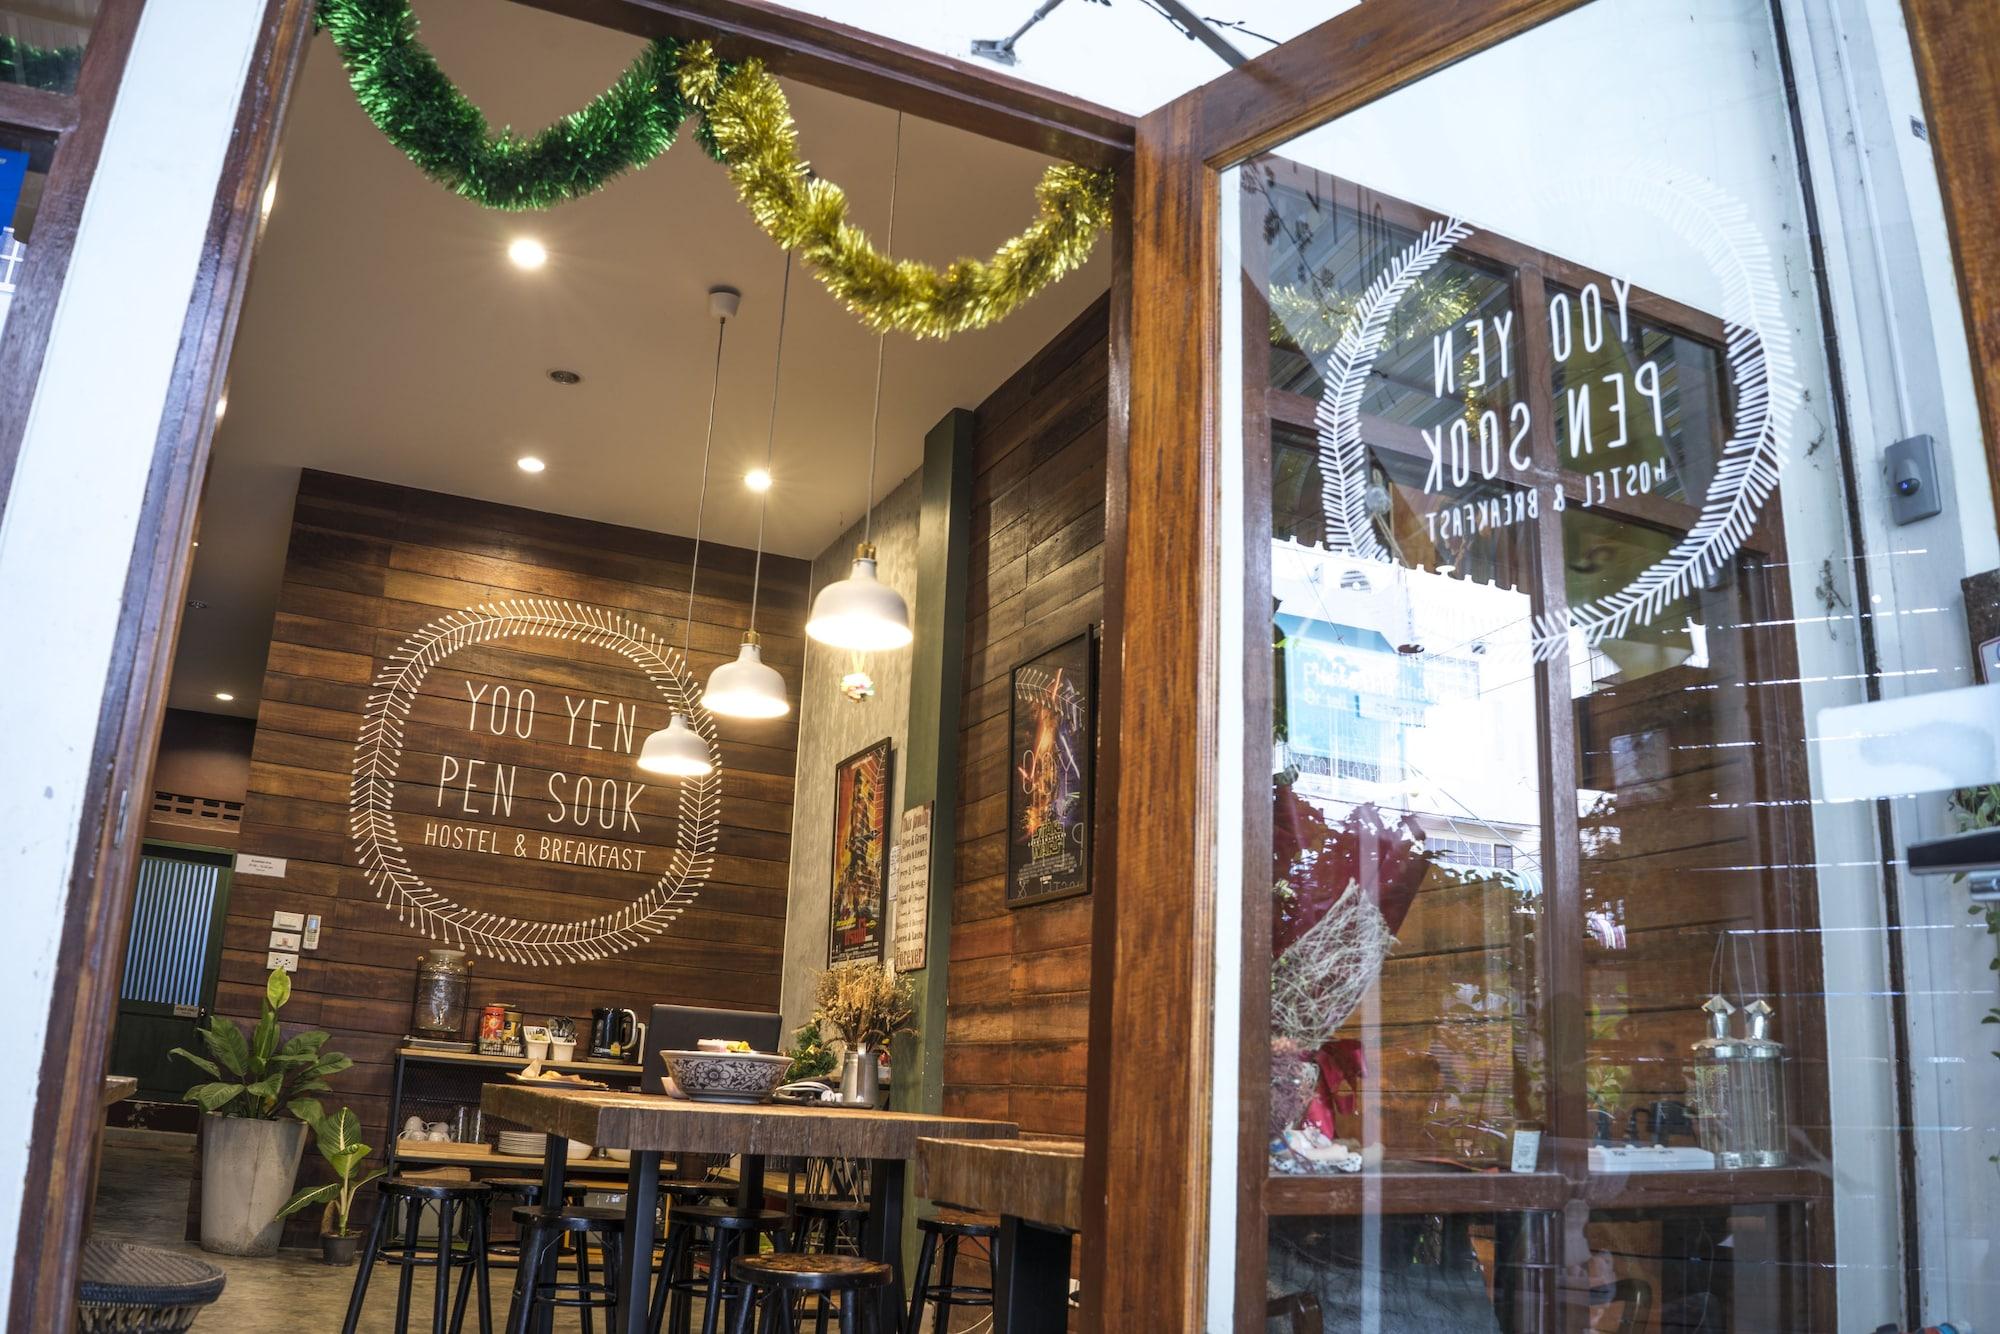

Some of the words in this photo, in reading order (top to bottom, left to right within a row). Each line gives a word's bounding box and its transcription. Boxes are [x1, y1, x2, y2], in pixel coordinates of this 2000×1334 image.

[466, 680, 535, 739] YOO
[565, 695, 637, 755] YEN
[437, 755, 516, 818] PEN
[547, 772, 646, 833] SOOK
[424, 823, 501, 855] HOSTEL
[514, 834, 527, 858] &
[540, 837, 647, 872] BREAKFAST
[896, 947, 923, 967] Forever
